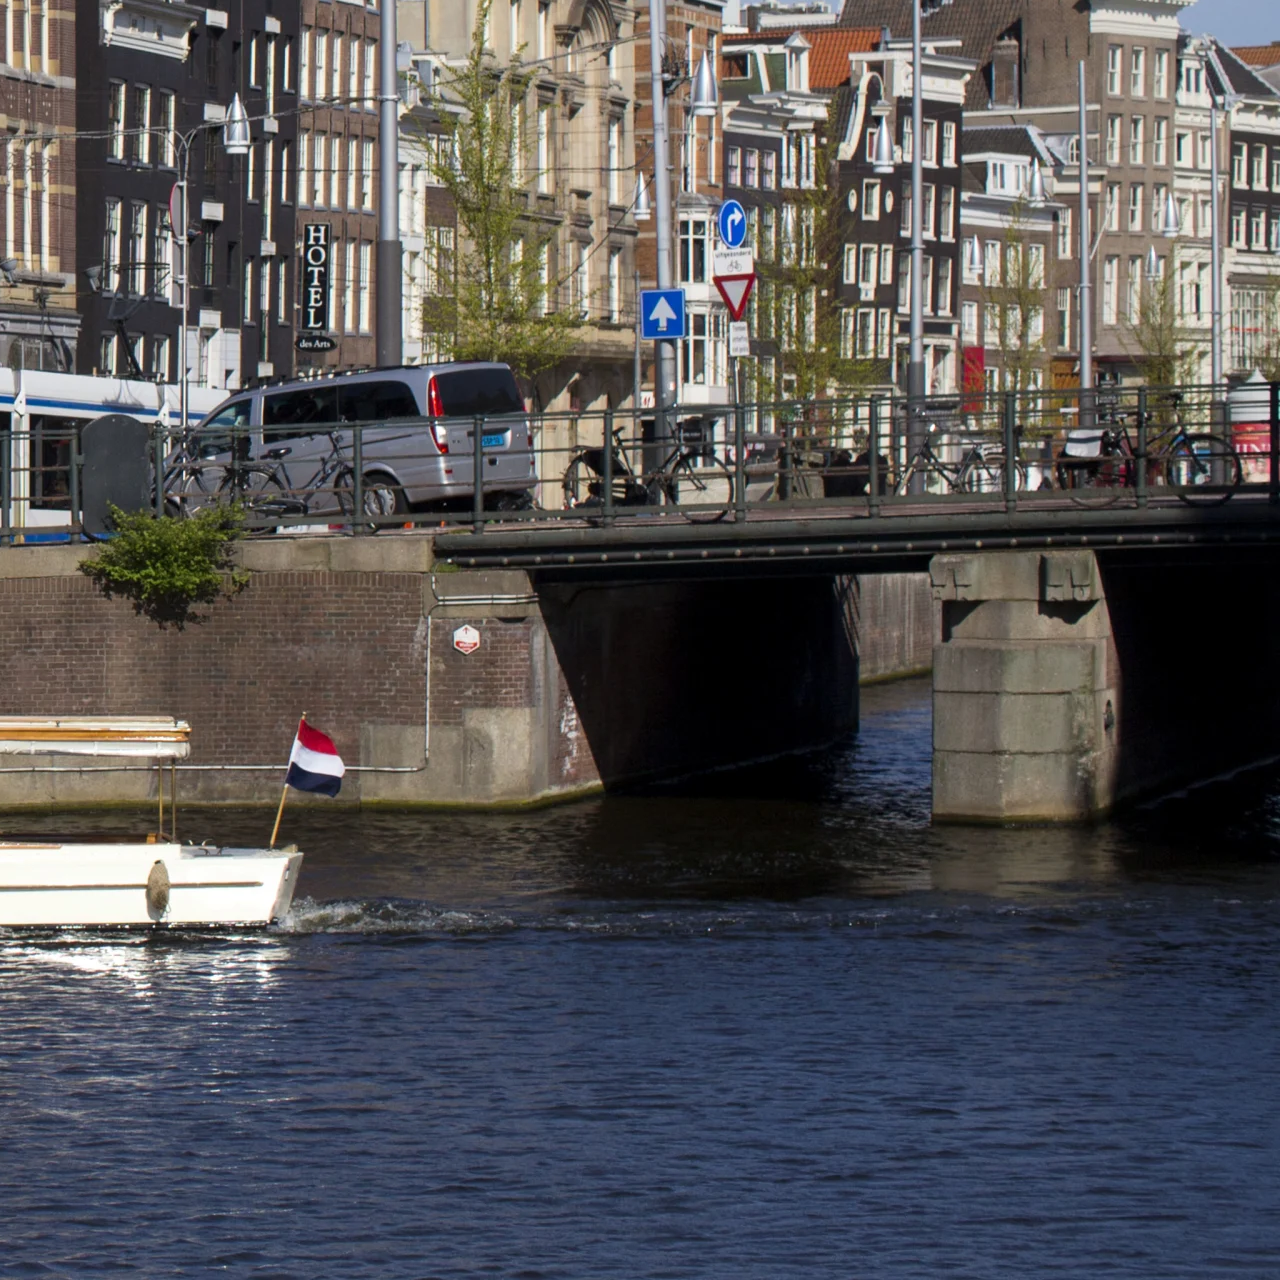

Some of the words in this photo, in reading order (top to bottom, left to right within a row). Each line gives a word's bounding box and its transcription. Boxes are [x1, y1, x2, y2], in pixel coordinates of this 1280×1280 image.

[307, 225, 326, 328] HOTEL
[300, 339, 312, 348] des
[314, 339, 331, 348] Arts
